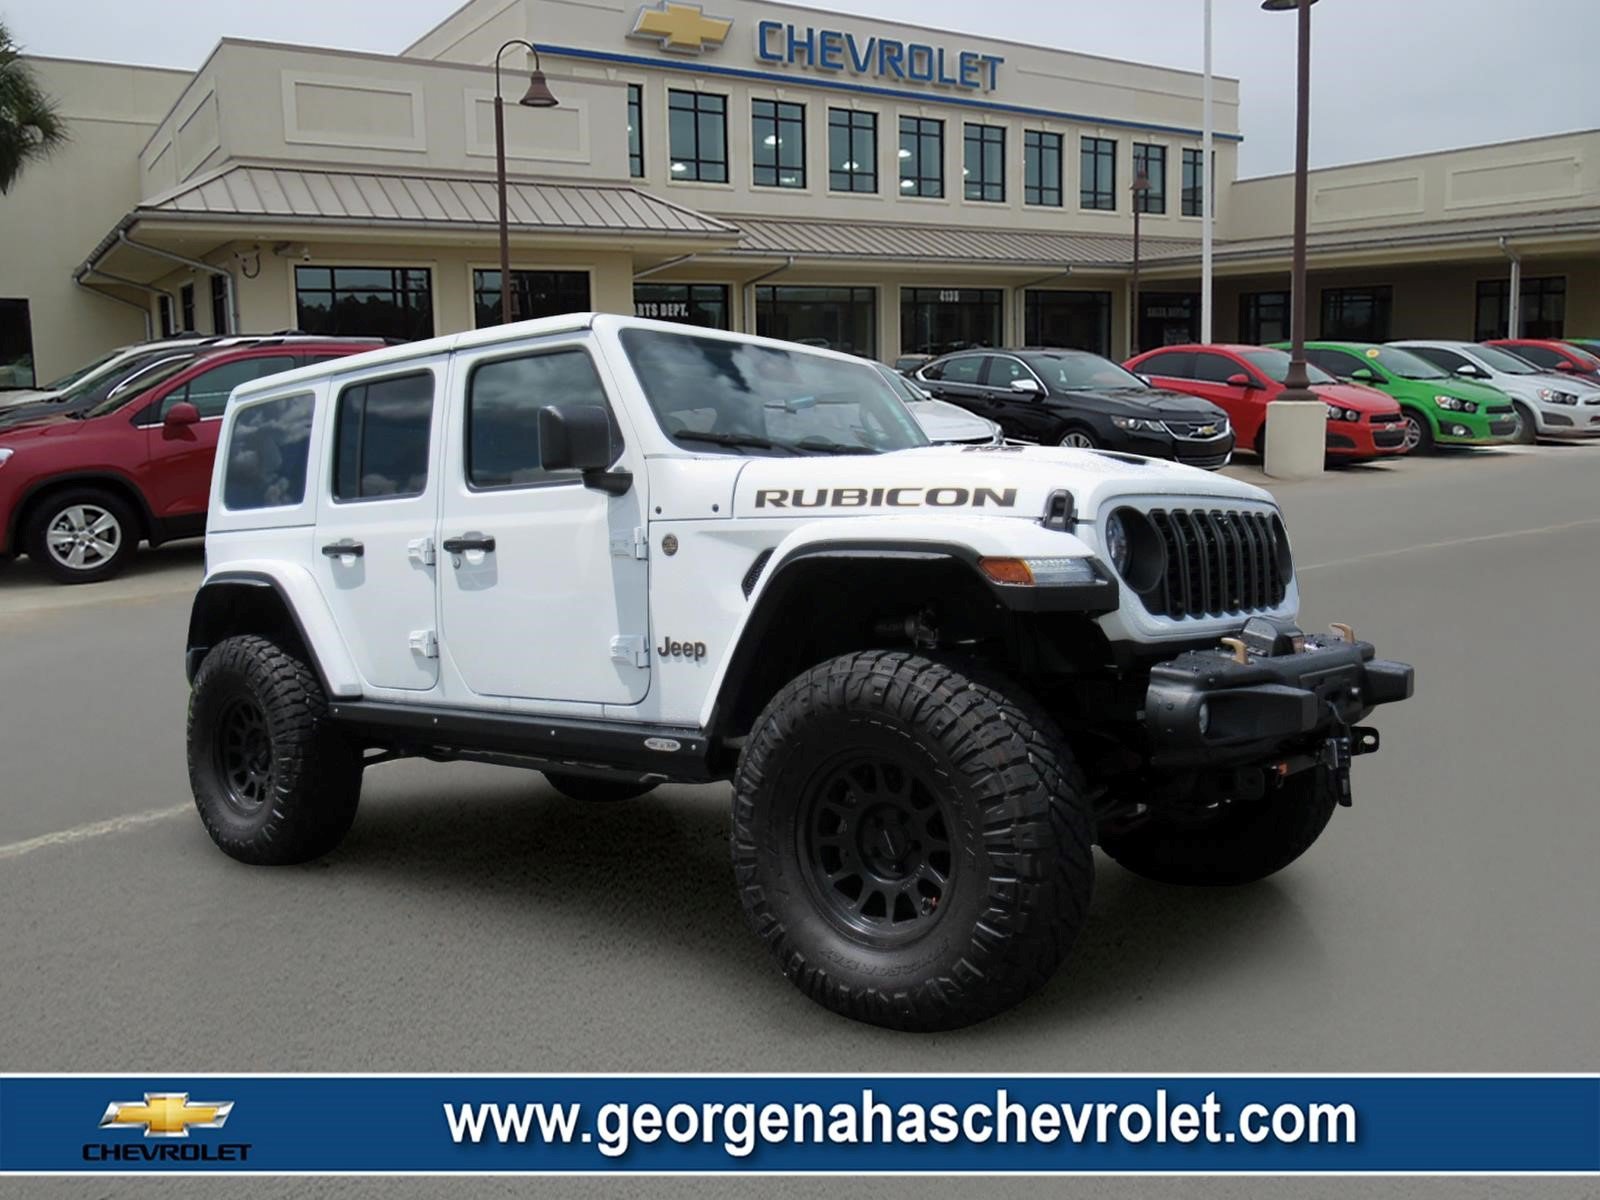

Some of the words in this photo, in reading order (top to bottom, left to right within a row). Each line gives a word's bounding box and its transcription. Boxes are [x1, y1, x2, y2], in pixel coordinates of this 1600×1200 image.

[758, 20, 1005, 91] CHEVROLET
[634, 303, 658, 317] RTS
[660, 303, 689, 317] DEPT.
[754, 487, 1018, 509] RUBICON
[657, 636, 706, 662] Jeep
